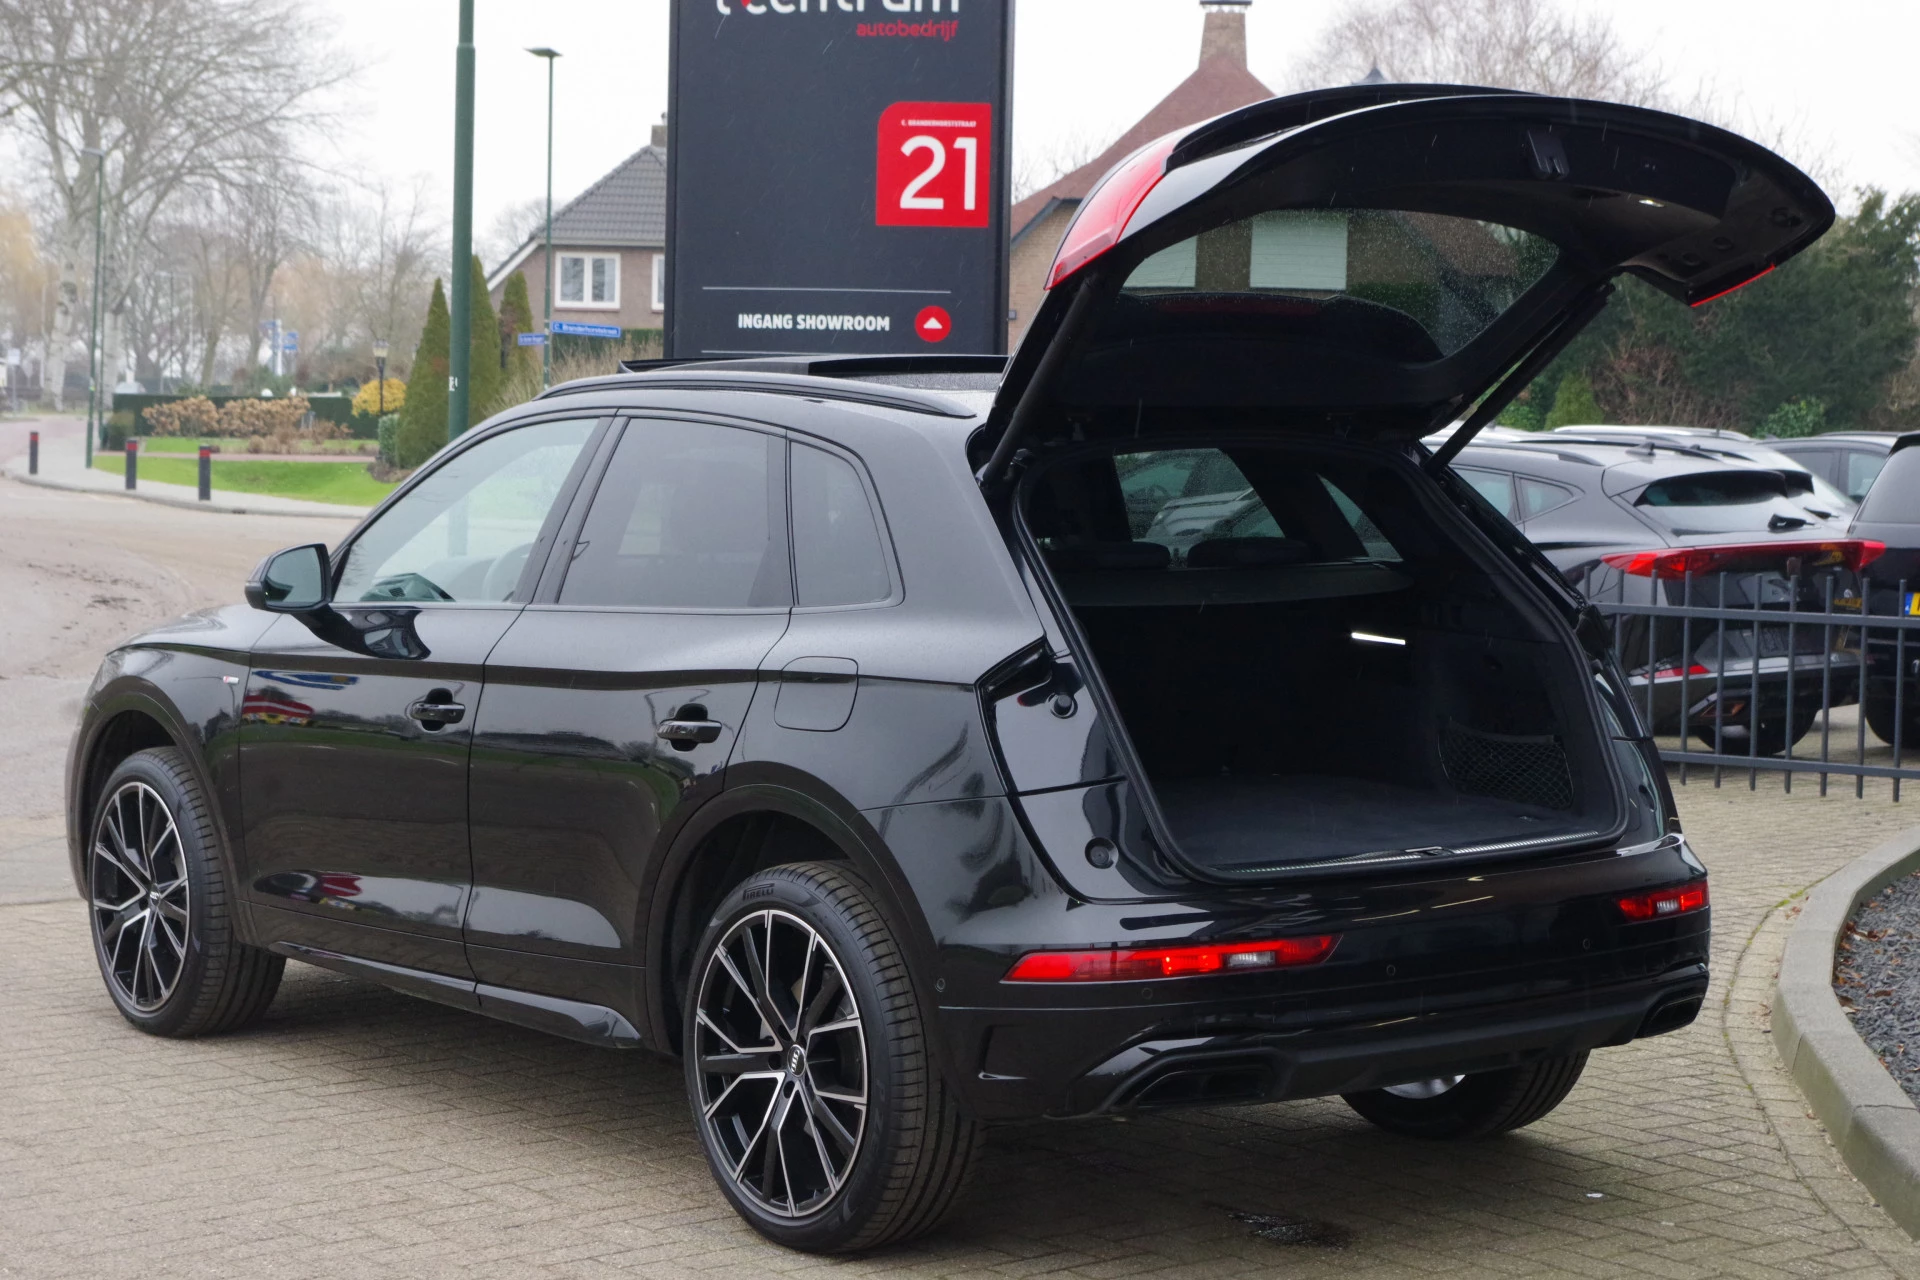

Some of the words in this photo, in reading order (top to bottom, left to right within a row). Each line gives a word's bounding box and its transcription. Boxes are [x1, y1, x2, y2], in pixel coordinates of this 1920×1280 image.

[856, 20, 959, 42] autobedrijf
[899, 135, 977, 210] 21
[738, 313, 793, 329] INGANG
[796, 315, 890, 331] SHOWROOM
